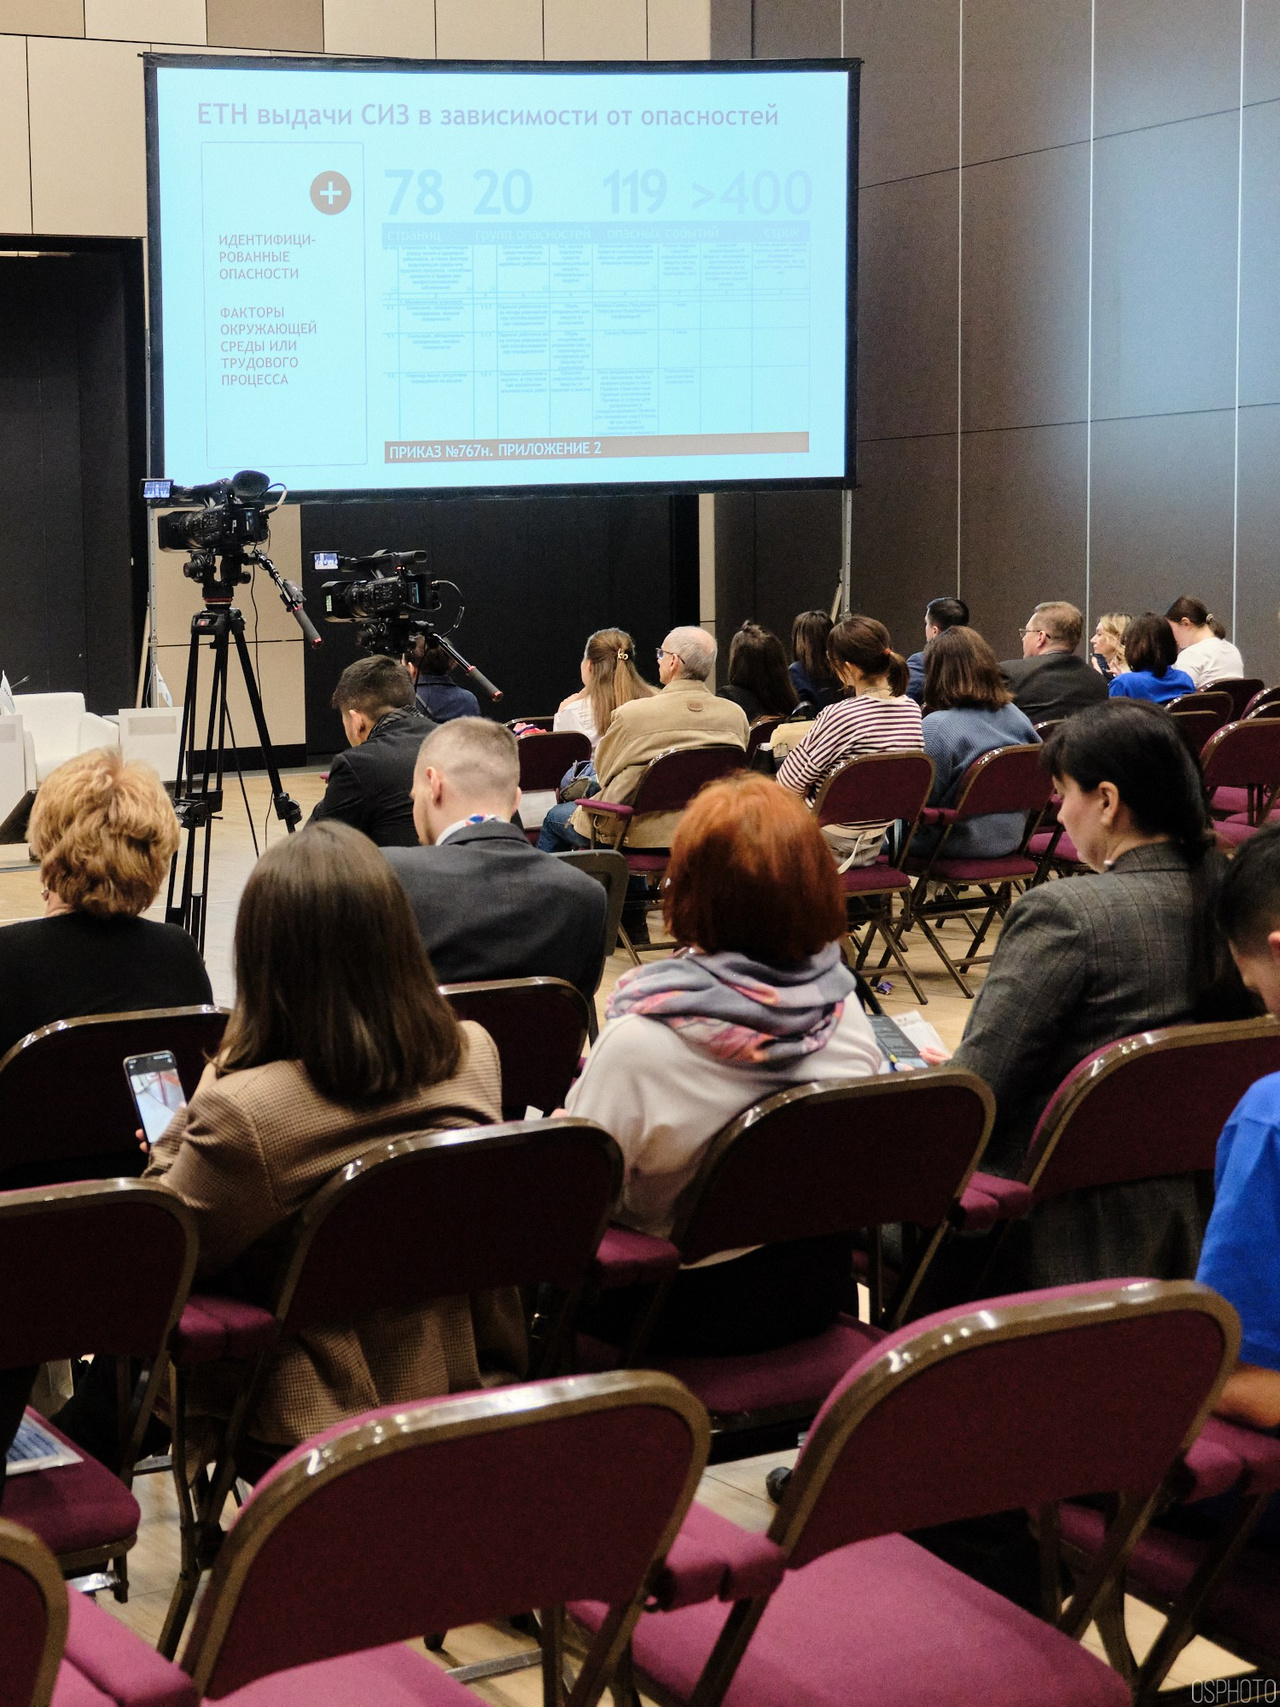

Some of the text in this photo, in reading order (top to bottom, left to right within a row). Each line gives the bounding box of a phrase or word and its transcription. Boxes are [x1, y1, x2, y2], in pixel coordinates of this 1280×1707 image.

[198, 103, 779, 130] ЕТН выдачи СИЗ в зависимости от опасностей
[384, 168, 445, 216] 78
[472, 168, 532, 216] 20
[603, 168, 667, 215] 119
[691, 169, 813, 215] >400
[387, 229, 441, 242] страниц
[475, 225, 591, 242] групп опасностей
[607, 225, 719, 240] опасных событий
[764, 228, 800, 241] строк
[219, 234, 316, 248] ИДЕНТИФИЦИ-
[220, 251, 290, 263] РОВАННЫЕ
[220, 268, 299, 279] ОПАСНОСТИ
[220, 307, 284, 318] ФАКТОРЫ
[221, 320, 317, 336] ОКРУЖАЮЩЕЙ
[221, 340, 297, 354] СРЕДЫ ИЛИ
[221, 357, 299, 371] ТРУДОВОГО
[222, 374, 289, 387] ПРОЦЕССА
[389, 441, 602, 459] ПРИКАЗ №767н. ПРИЛОЖЕНИЕ 2
